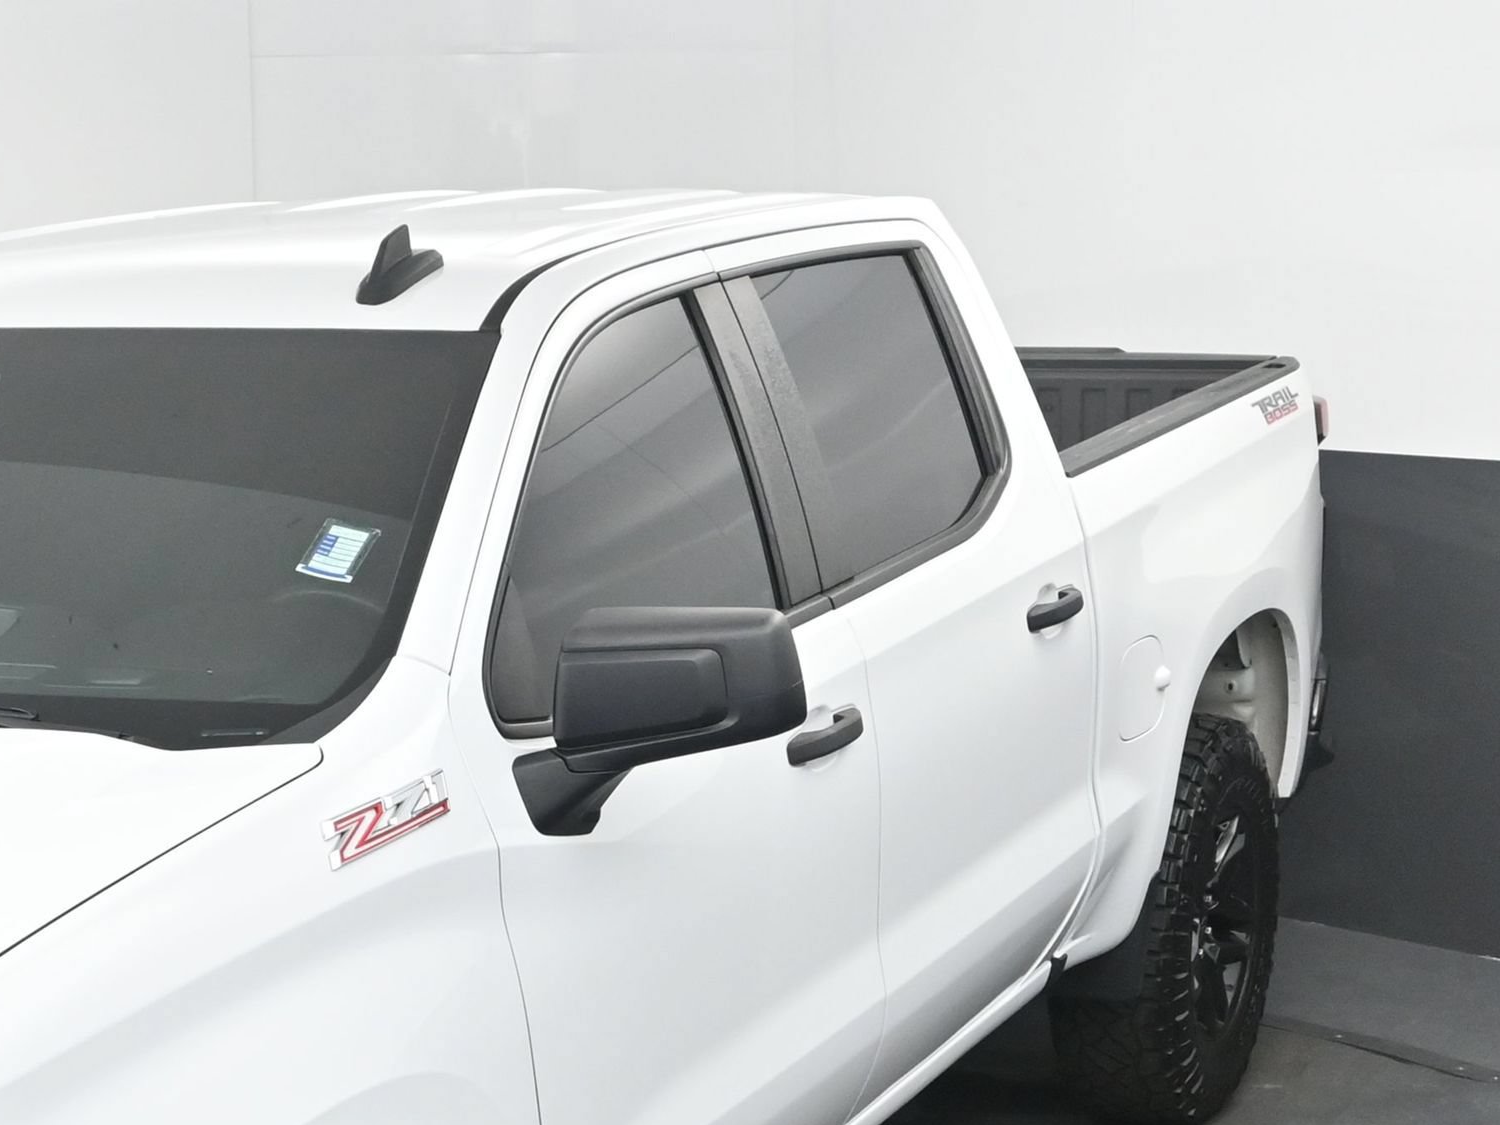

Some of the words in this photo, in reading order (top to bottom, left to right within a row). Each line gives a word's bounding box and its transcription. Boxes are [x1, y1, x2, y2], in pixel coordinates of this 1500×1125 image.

[1251, 386, 1299, 414] TRAIL
[1263, 399, 1299, 425] BOSS
[321, 768, 451, 872] Z71
